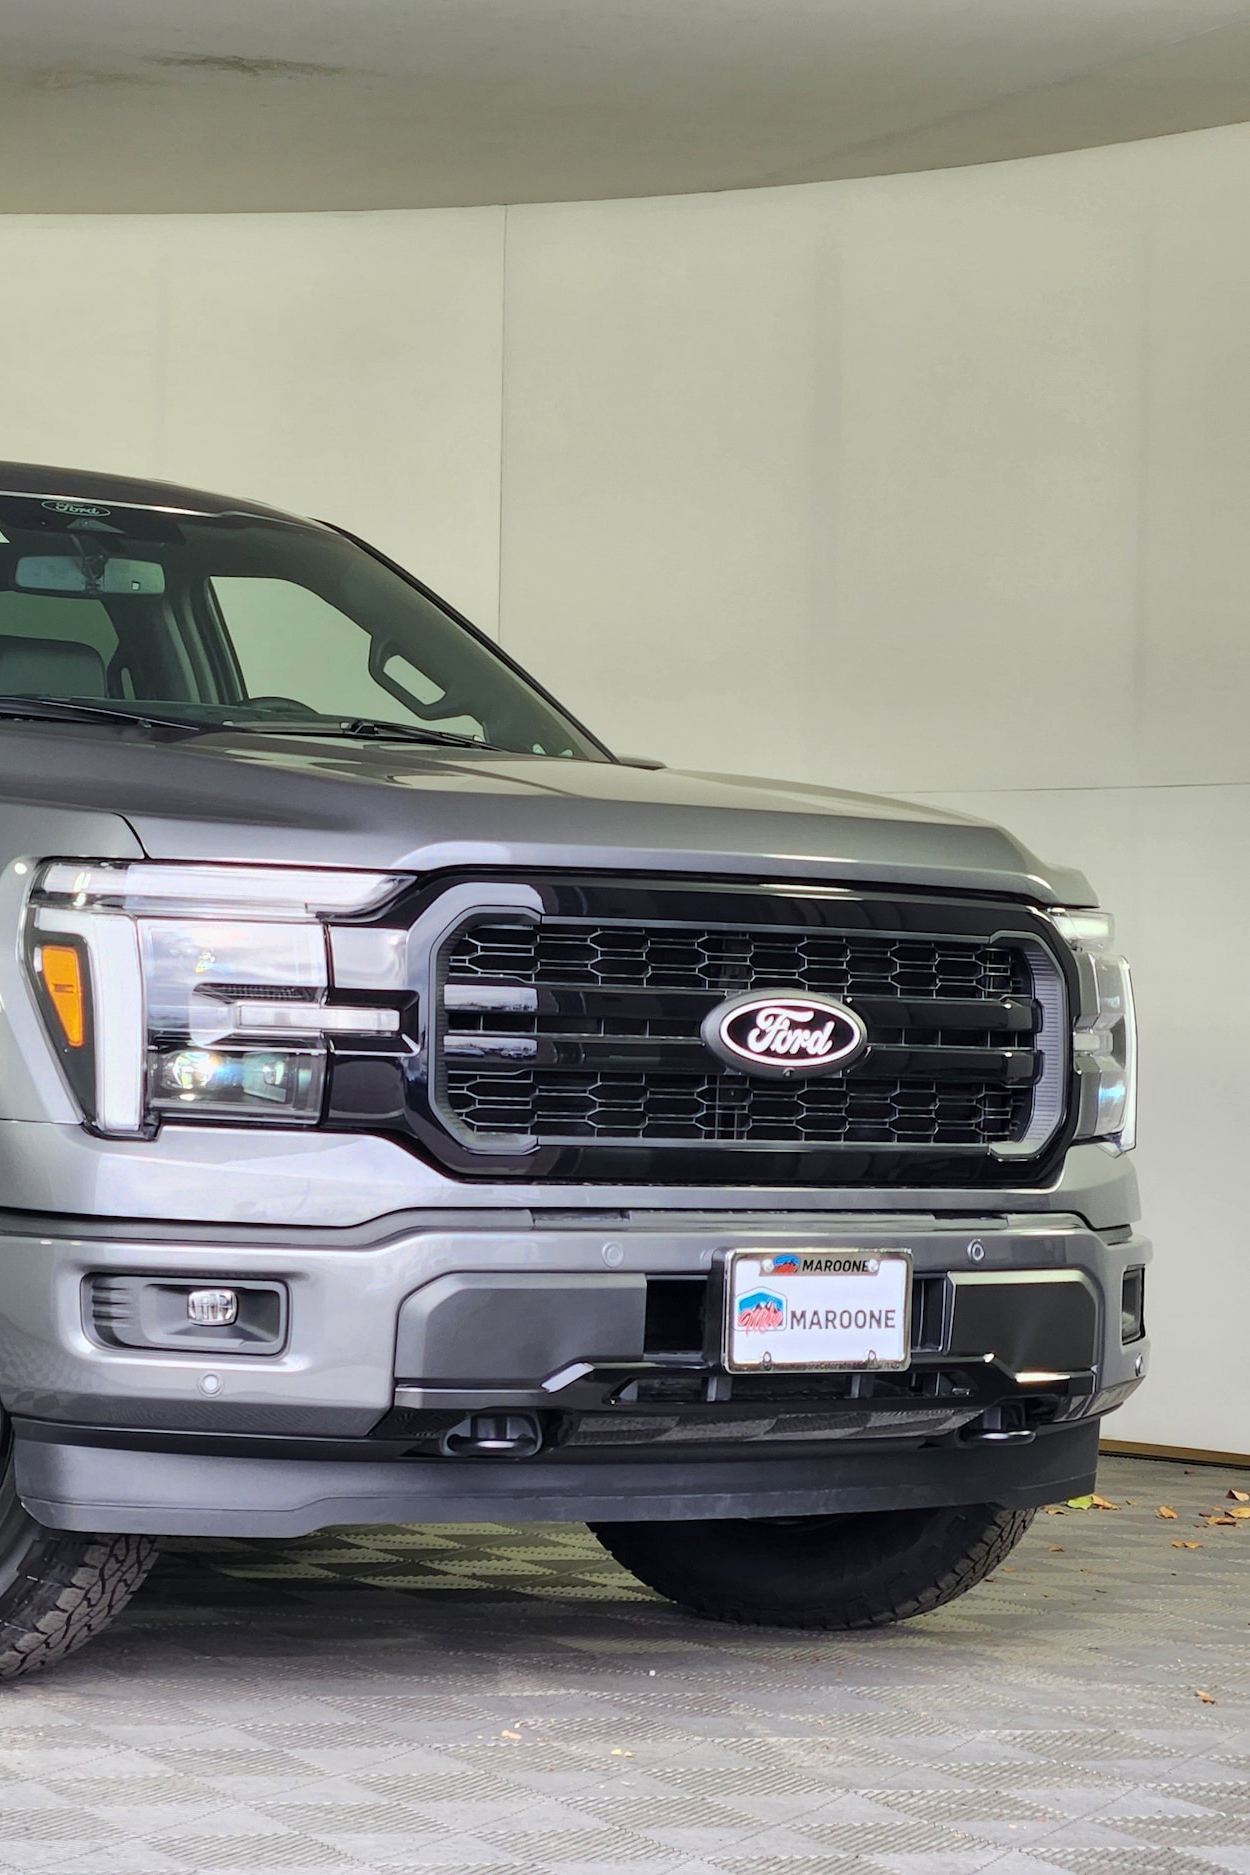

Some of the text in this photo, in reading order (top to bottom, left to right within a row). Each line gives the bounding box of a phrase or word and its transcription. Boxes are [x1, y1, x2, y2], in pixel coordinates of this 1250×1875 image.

[55, 502, 100, 516] Ford
[748, 1007, 835, 1055] Ford
[802, 1259, 870, 1273] MAROONE
[789, 1309, 896, 1330] MAROONE
